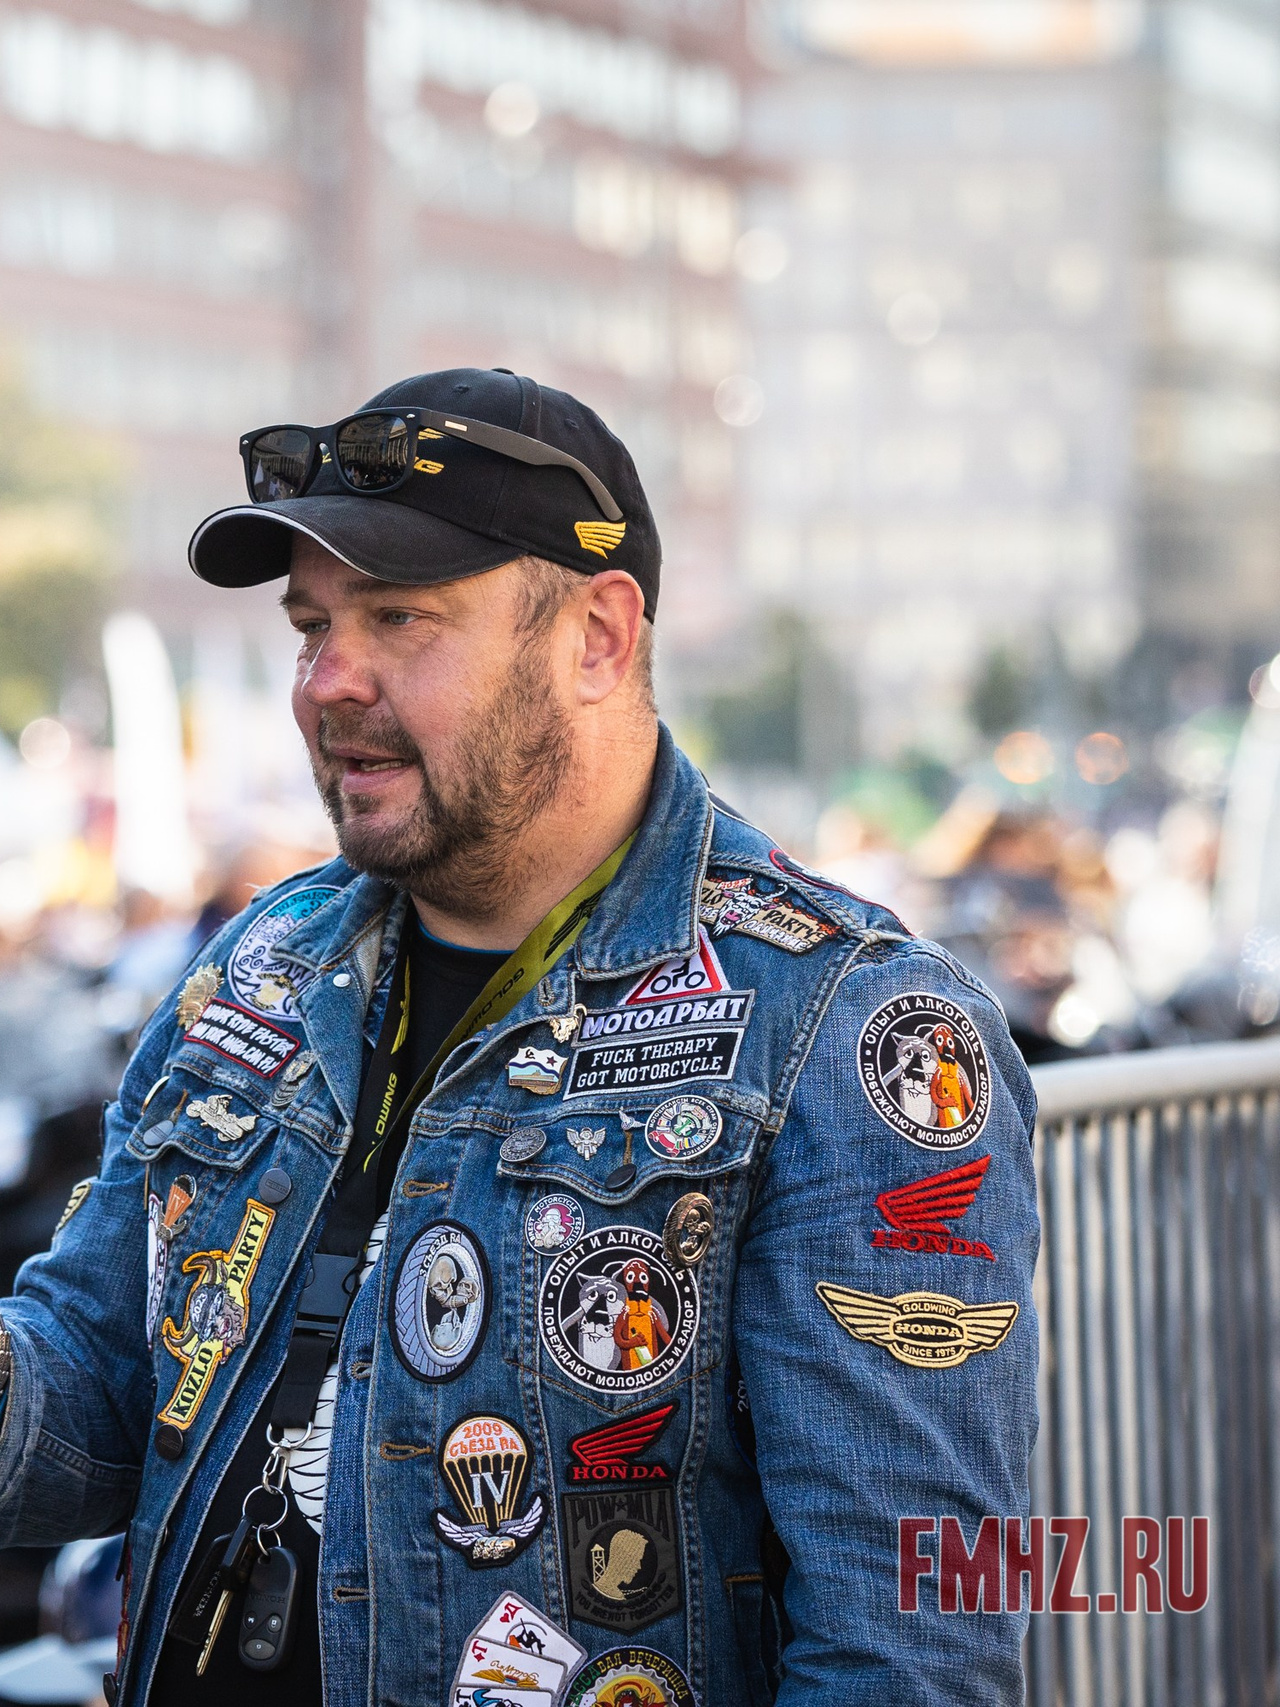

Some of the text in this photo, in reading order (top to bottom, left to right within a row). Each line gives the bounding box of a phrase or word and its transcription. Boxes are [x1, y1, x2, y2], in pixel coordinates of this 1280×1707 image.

[762, 909, 818, 940] PARTY
[459, 967, 525, 1043] GOLDWIN
[580, 998, 746, 1039] МОТОАРБАТ
[227, 1013, 258, 1035] RIDE
[249, 1026, 296, 1058] FASTER
[864, 998, 981, 1053] ОПЫТ И АЛКОГОЛЬ
[242, 1046, 267, 1067] CAN
[257, 1055, 281, 1075] FLY
[591, 1037, 718, 1067] FUCK THERAPY
[577, 1056, 724, 1088] GOT MOTORCYCLE
[863, 1062, 988, 1145] ПОБЕЖДАЮТ МОЛОДОСТЬ И ЗАДОР
[528, 1196, 582, 1249] BREST MOTORCYCLE FESTIVAL
[549, 1231, 686, 1287] ОПЫТ И АЛКОГЬ
[871, 1229, 997, 1263] HONDA
[171, 1212, 267, 1419] KOZLO PARTY
[191, 1291, 208, 1322] 2023
[902, 1301, 958, 1317] GOLDWING
[543, 1300, 695, 1389] ПОБЕЖДАЮТ МОЛОДОСТЬ И ЗАДОР
[895, 1322, 964, 1338] HONDA
[902, 1344, 957, 1358] SINCE 1975
[449, 1438, 497, 1457] СЪЕЗД
[463, 1421, 503, 1439] 2009
[470, 1470, 510, 1508] IV
[572, 1465, 668, 1481] HONDA
[629, 1583, 676, 1621] FORGOTTEN
[629, 1650, 689, 1700] ВЕЧЕРИНКА
